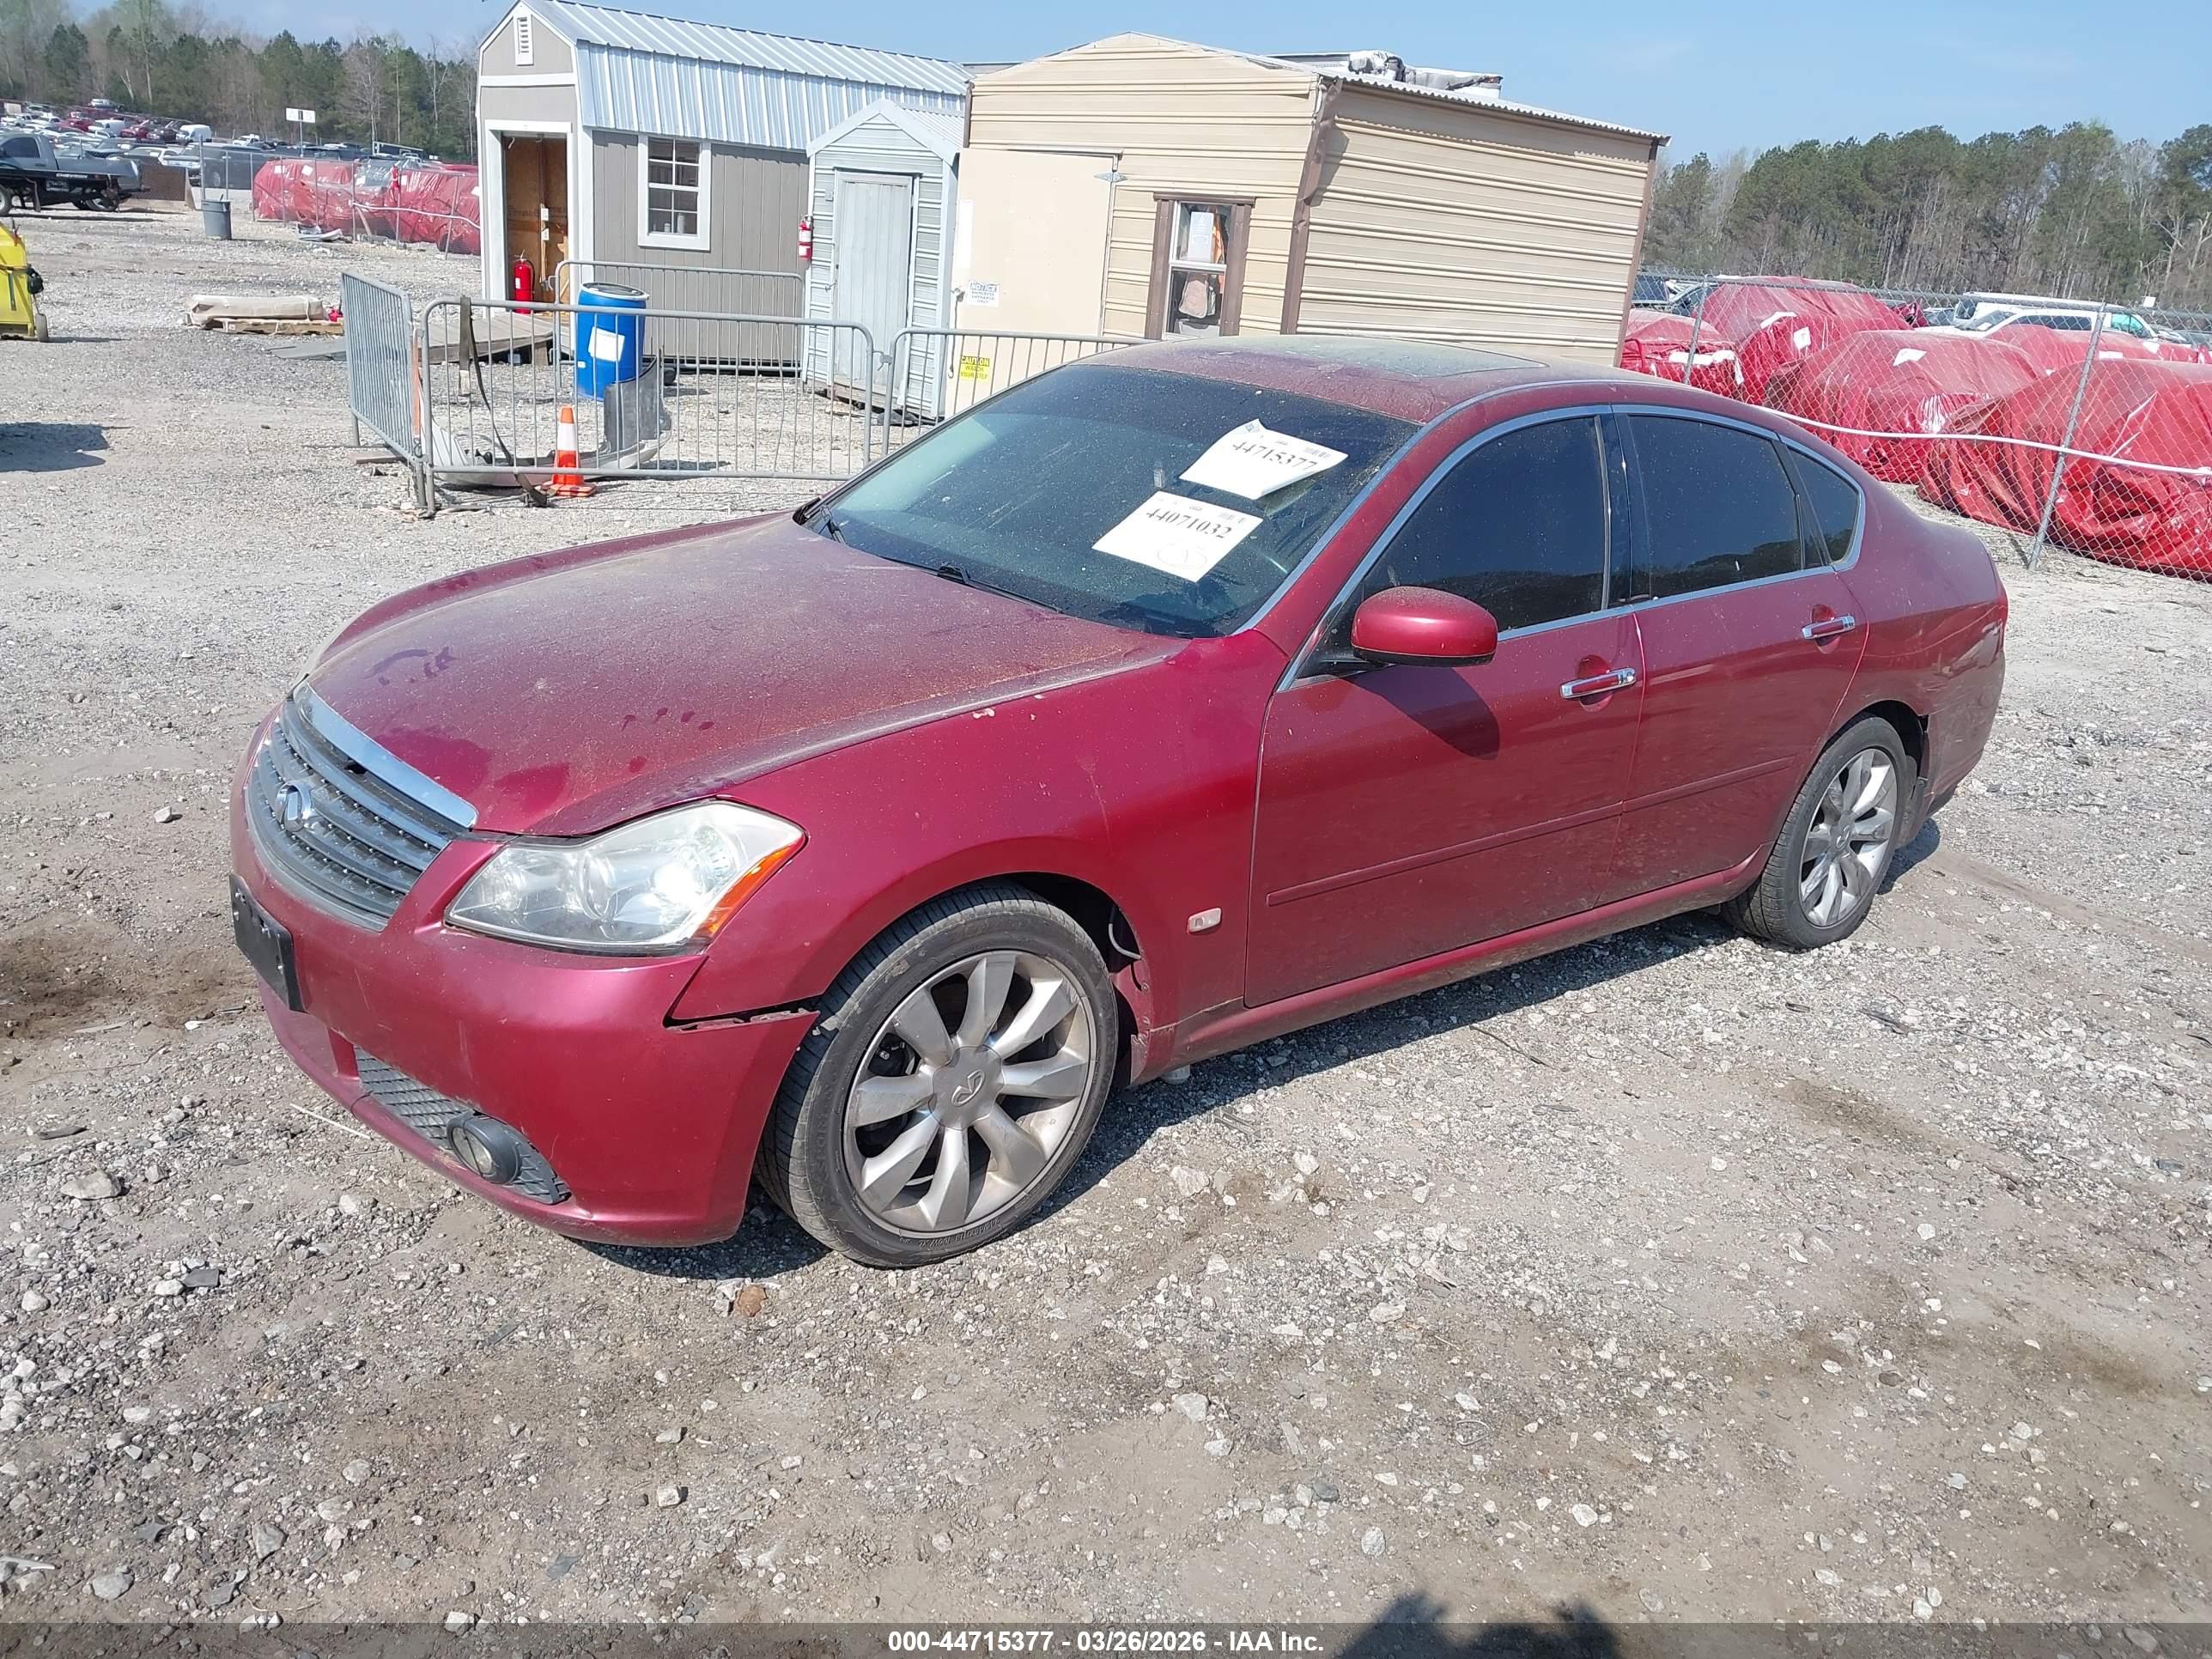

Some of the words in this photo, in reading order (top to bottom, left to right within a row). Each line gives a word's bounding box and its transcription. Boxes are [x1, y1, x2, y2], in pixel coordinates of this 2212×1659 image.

[961, 356, 989, 367] CAUTON
[1232, 441, 1317, 471] 44715377
[1146, 508, 1231, 538] 44071032
